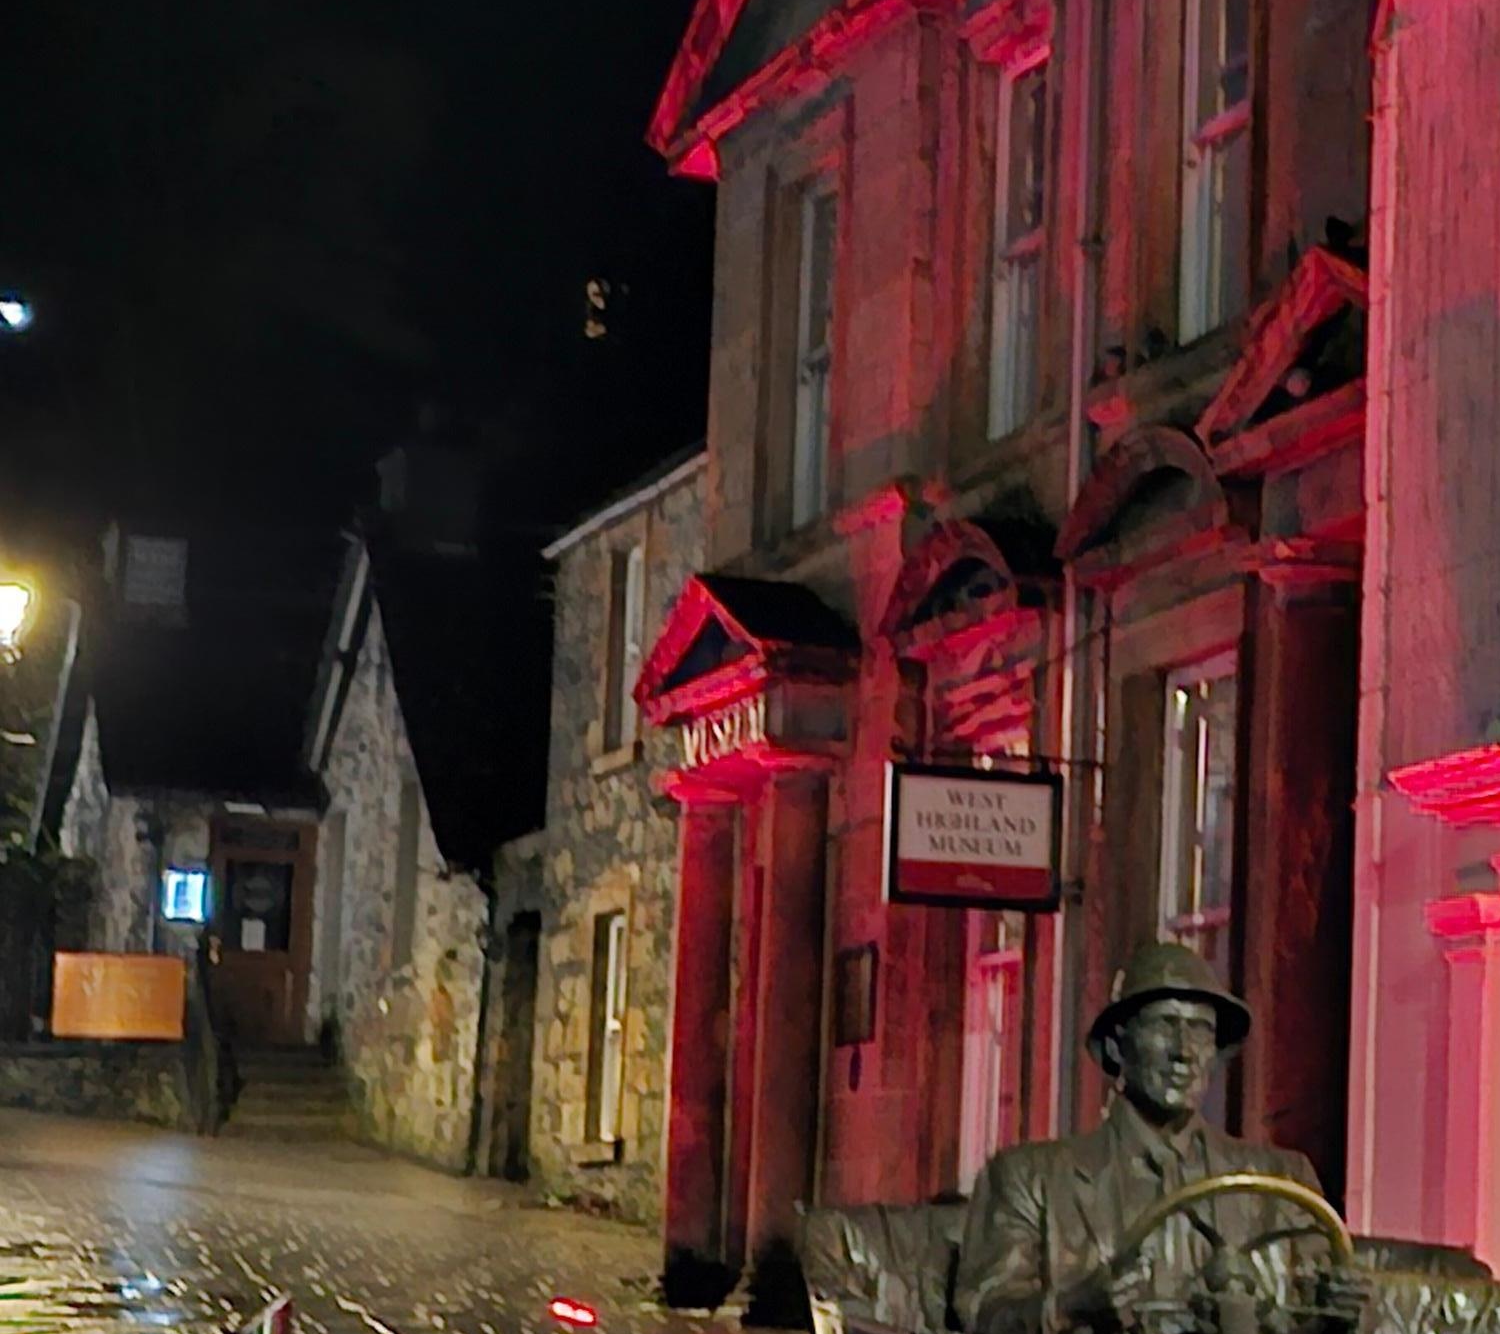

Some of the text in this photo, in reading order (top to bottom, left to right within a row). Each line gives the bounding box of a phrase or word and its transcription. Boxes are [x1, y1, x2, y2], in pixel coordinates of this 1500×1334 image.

[680, 693, 769, 771] MUSEUM
[946, 788, 1008, 811] WEST
[915, 810, 1037, 836] HIGHLAND
[928, 833, 1023, 857] MUSEUM
